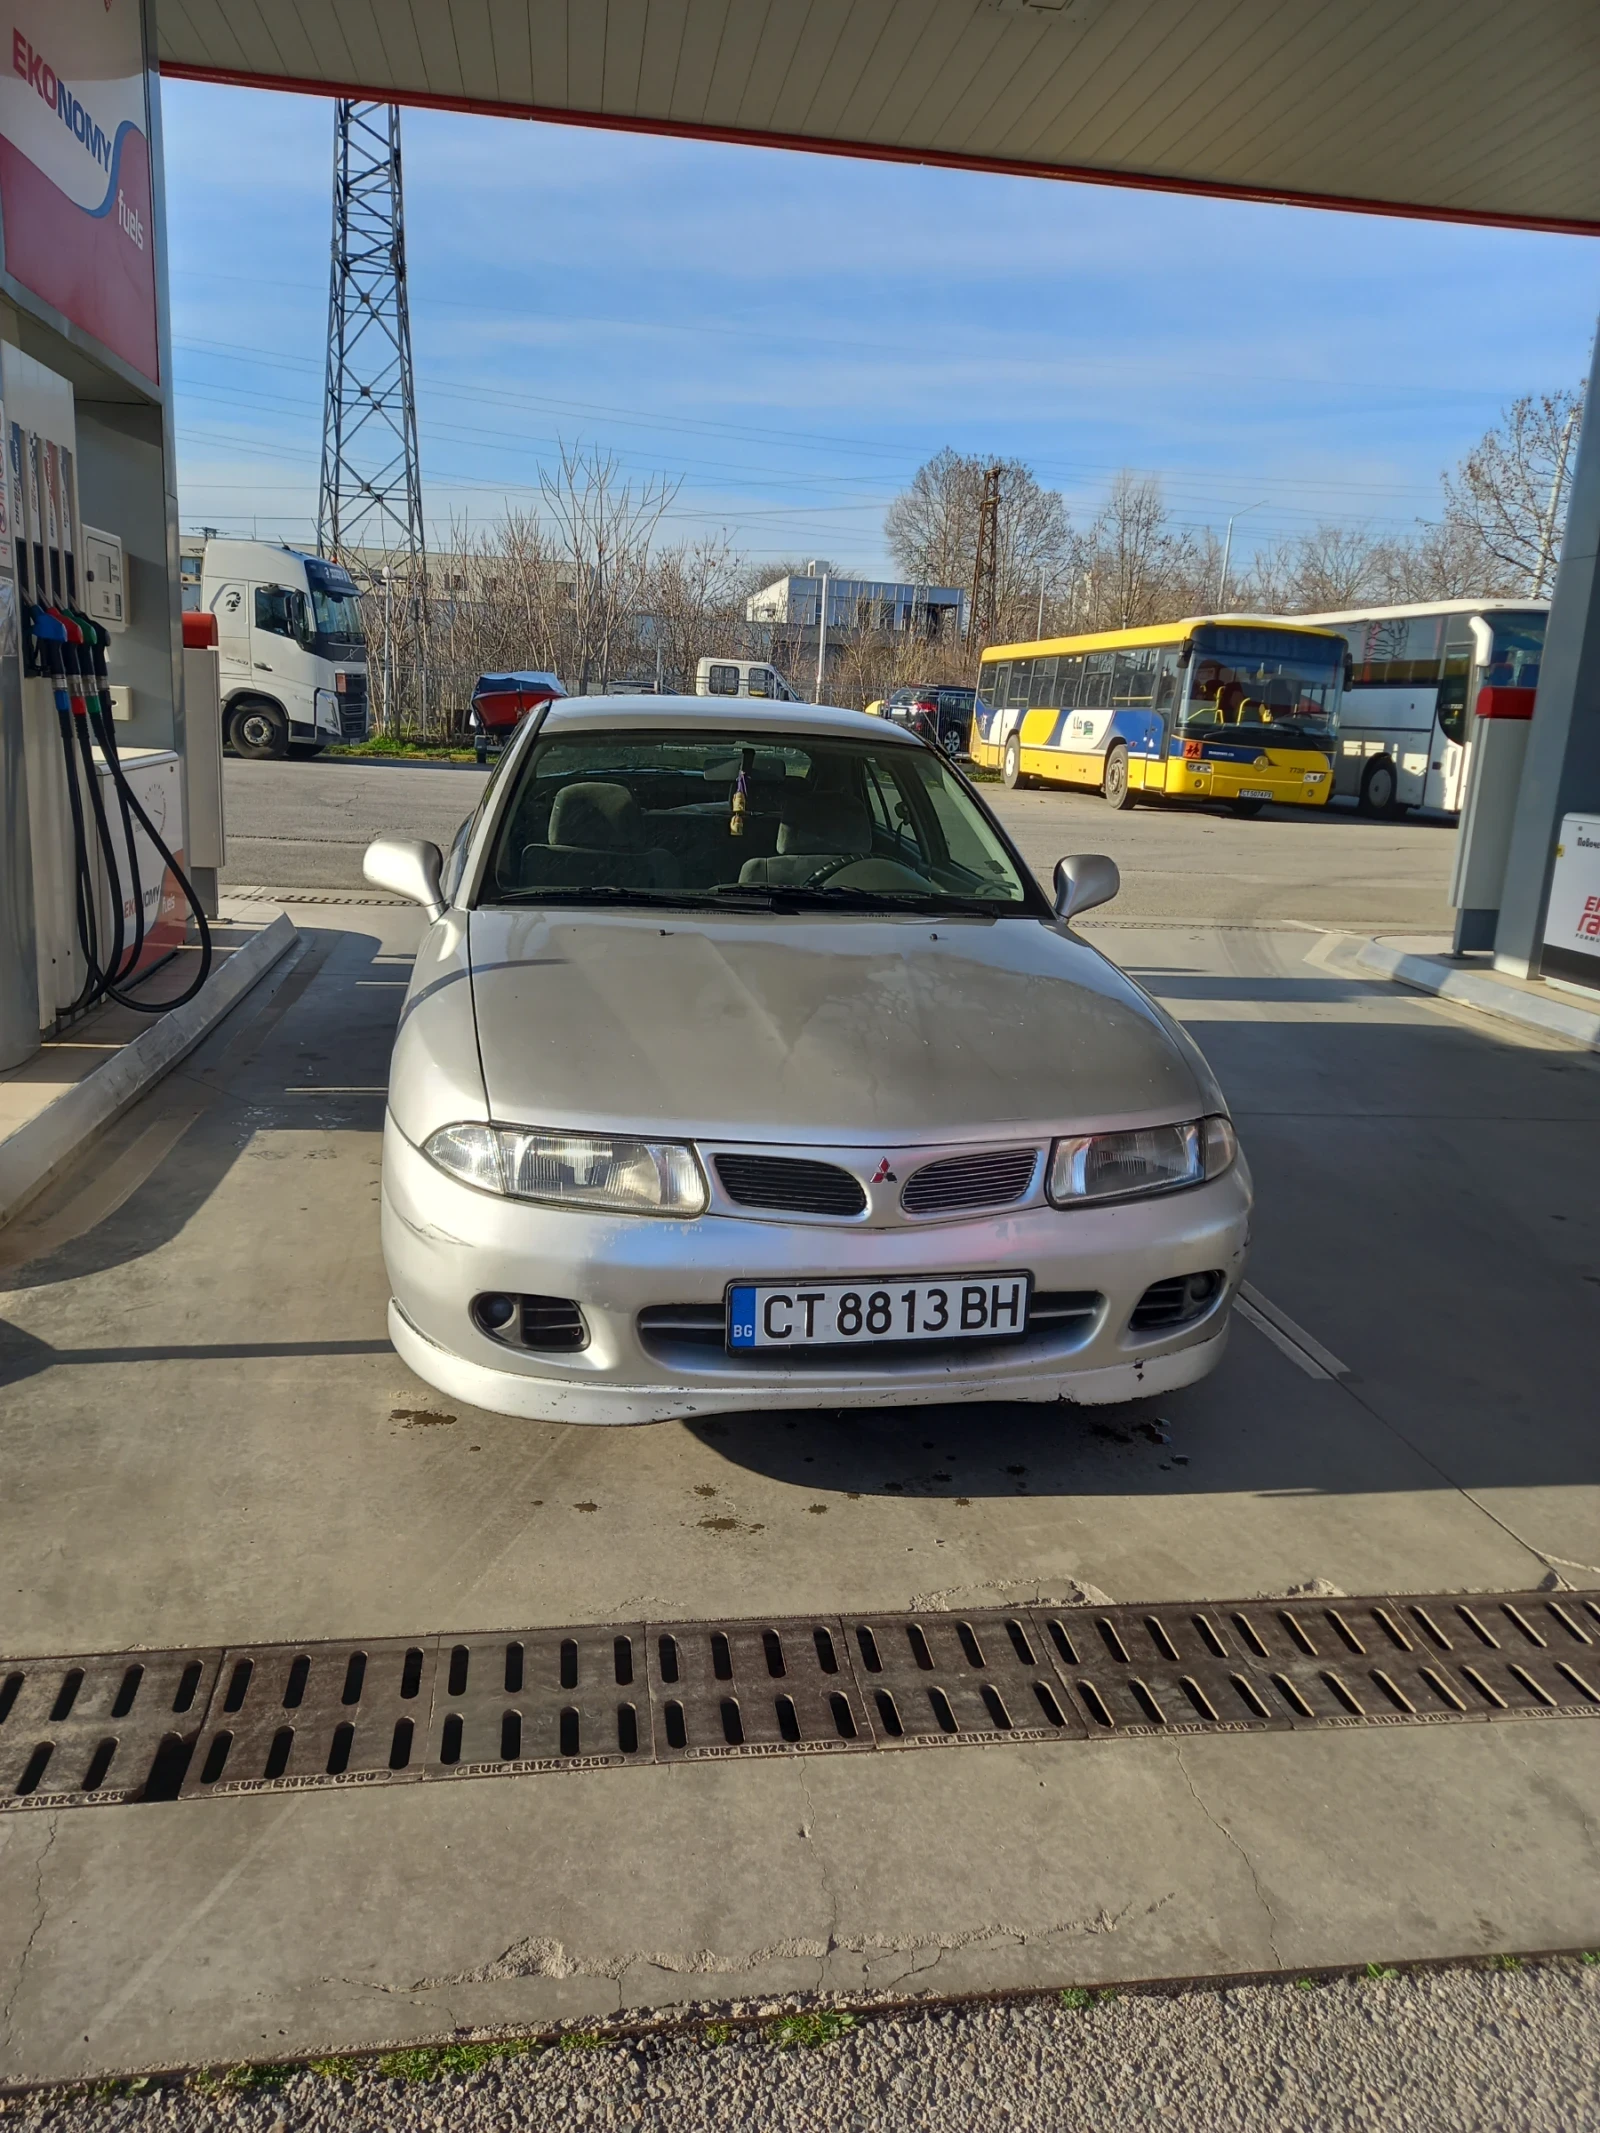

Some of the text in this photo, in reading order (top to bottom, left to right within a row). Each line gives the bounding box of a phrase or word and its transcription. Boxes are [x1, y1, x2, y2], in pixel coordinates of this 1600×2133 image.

[13, 27, 112, 173] EKONOMY
[117, 188, 144, 250] fuels
[763, 1284, 1020, 1338] CT 8813 BH
[733, 1325, 753, 1338] BG
[956, 1732, 1003, 1743] EN124
[1009, 1730, 1046, 1740] C250
[740, 1744, 787, 1755] EN124
[796, 1741, 832, 1751] C250
[511, 1759, 561, 1771] EN124
[570, 1756, 610, 1767] C250
[272, 1775, 324, 1788] EN124
[334, 1772, 376, 1783] C250
[21, 1794, 79, 1807] EN124
